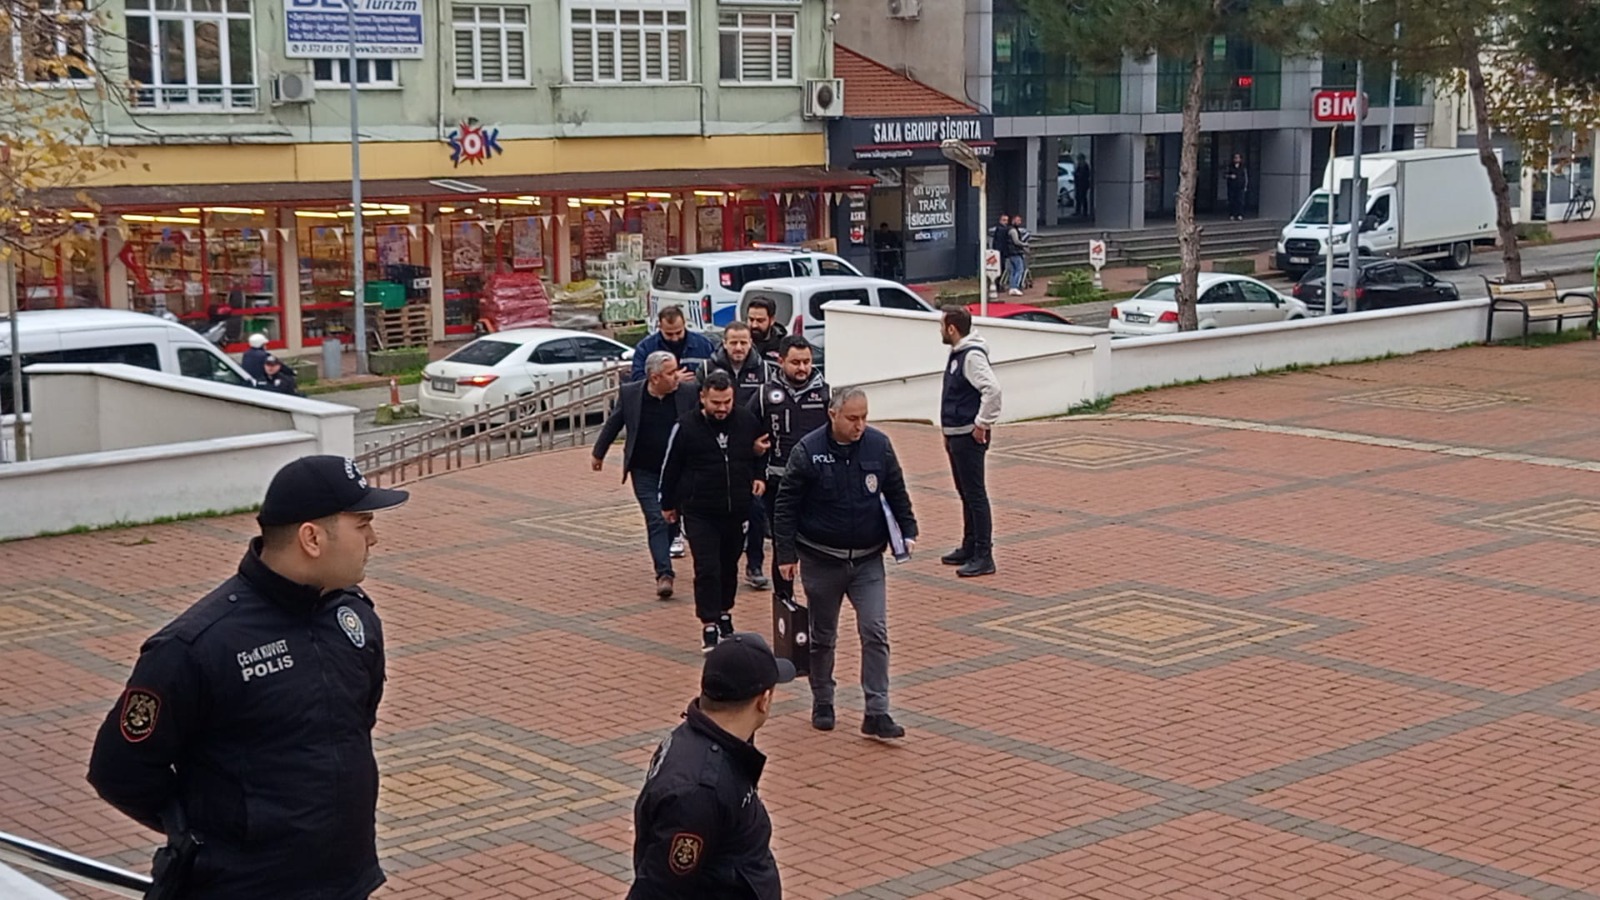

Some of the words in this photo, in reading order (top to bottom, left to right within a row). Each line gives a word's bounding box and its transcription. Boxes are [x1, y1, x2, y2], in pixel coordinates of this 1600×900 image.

[1318, 92, 1357, 117] BİM
[874, 123, 902, 143] SAKA
[904, 121, 938, 142] GROUP
[939, 116, 981, 140] SİGORTA
[919, 198, 947, 211] TRAFİK
[242, 655, 294, 681] POLİS
